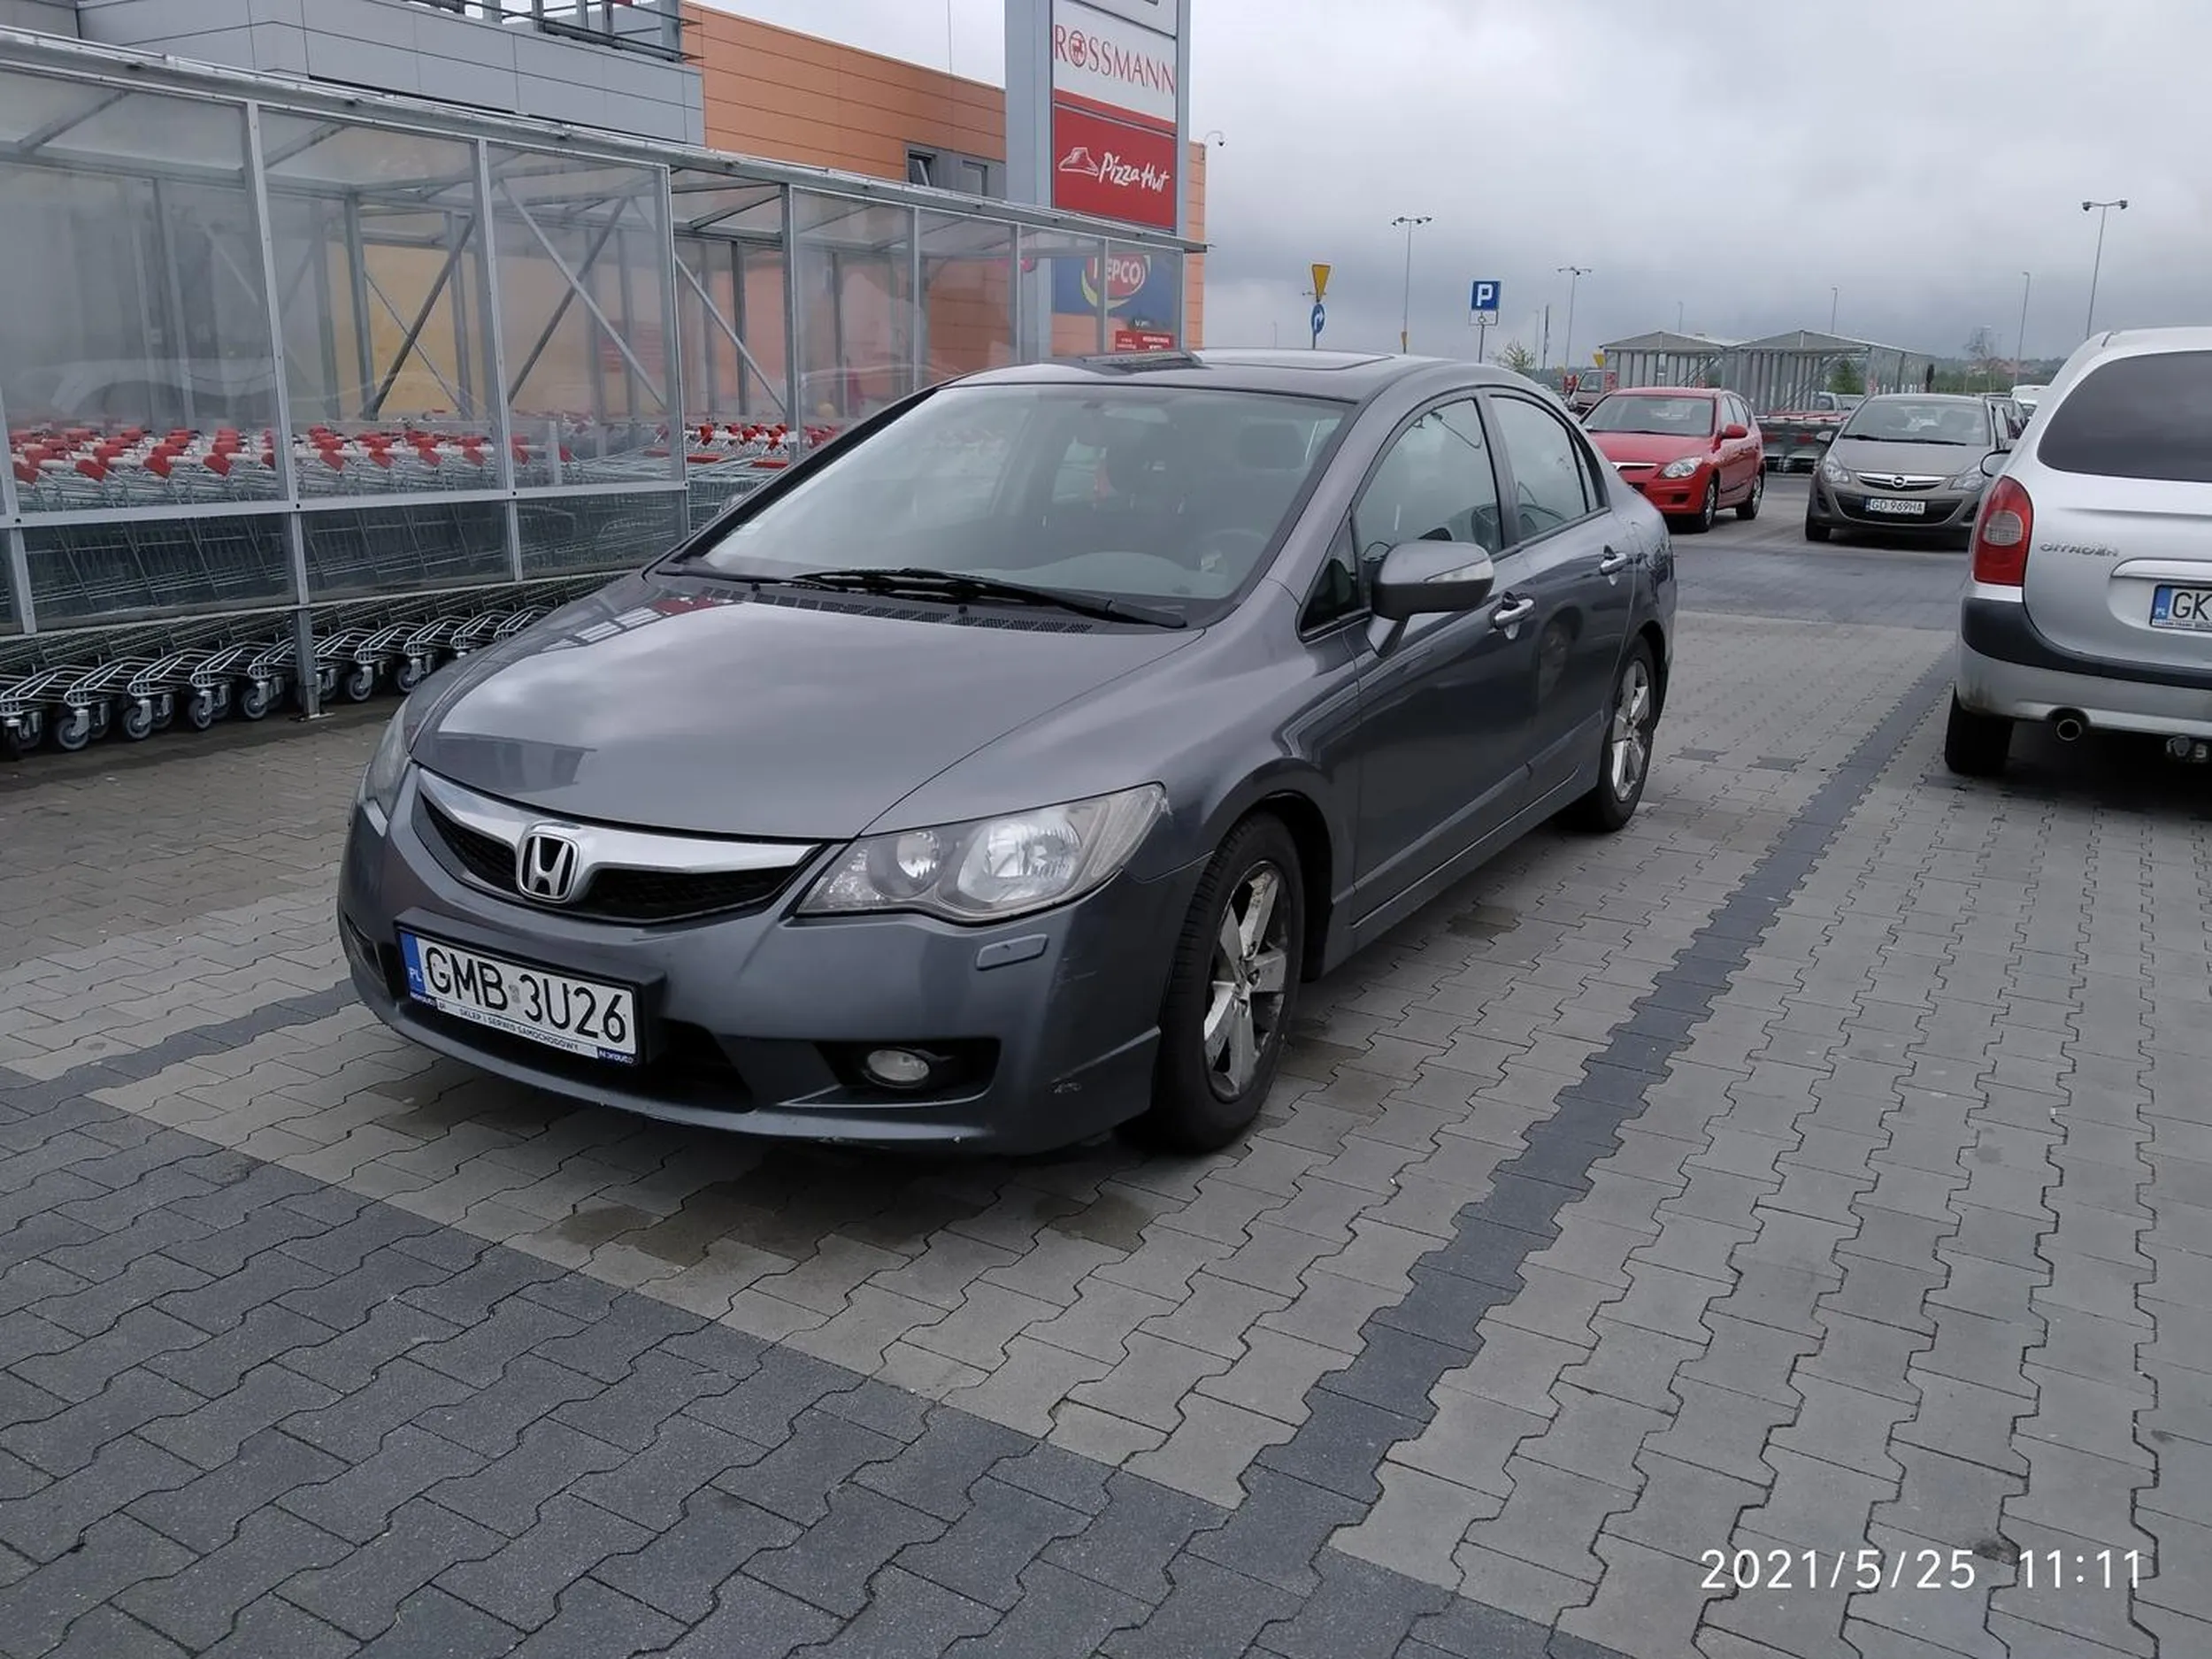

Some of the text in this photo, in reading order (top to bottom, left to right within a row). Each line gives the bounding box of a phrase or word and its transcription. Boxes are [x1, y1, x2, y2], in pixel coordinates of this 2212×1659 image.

[1054, 23, 1175, 96] ROSSMANN
[1098, 151, 1171, 192] Pizza Hut
[1477, 284, 1493, 306] P
[409, 966, 423, 983] PL
[426, 947, 626, 1044] GMB 3U26
